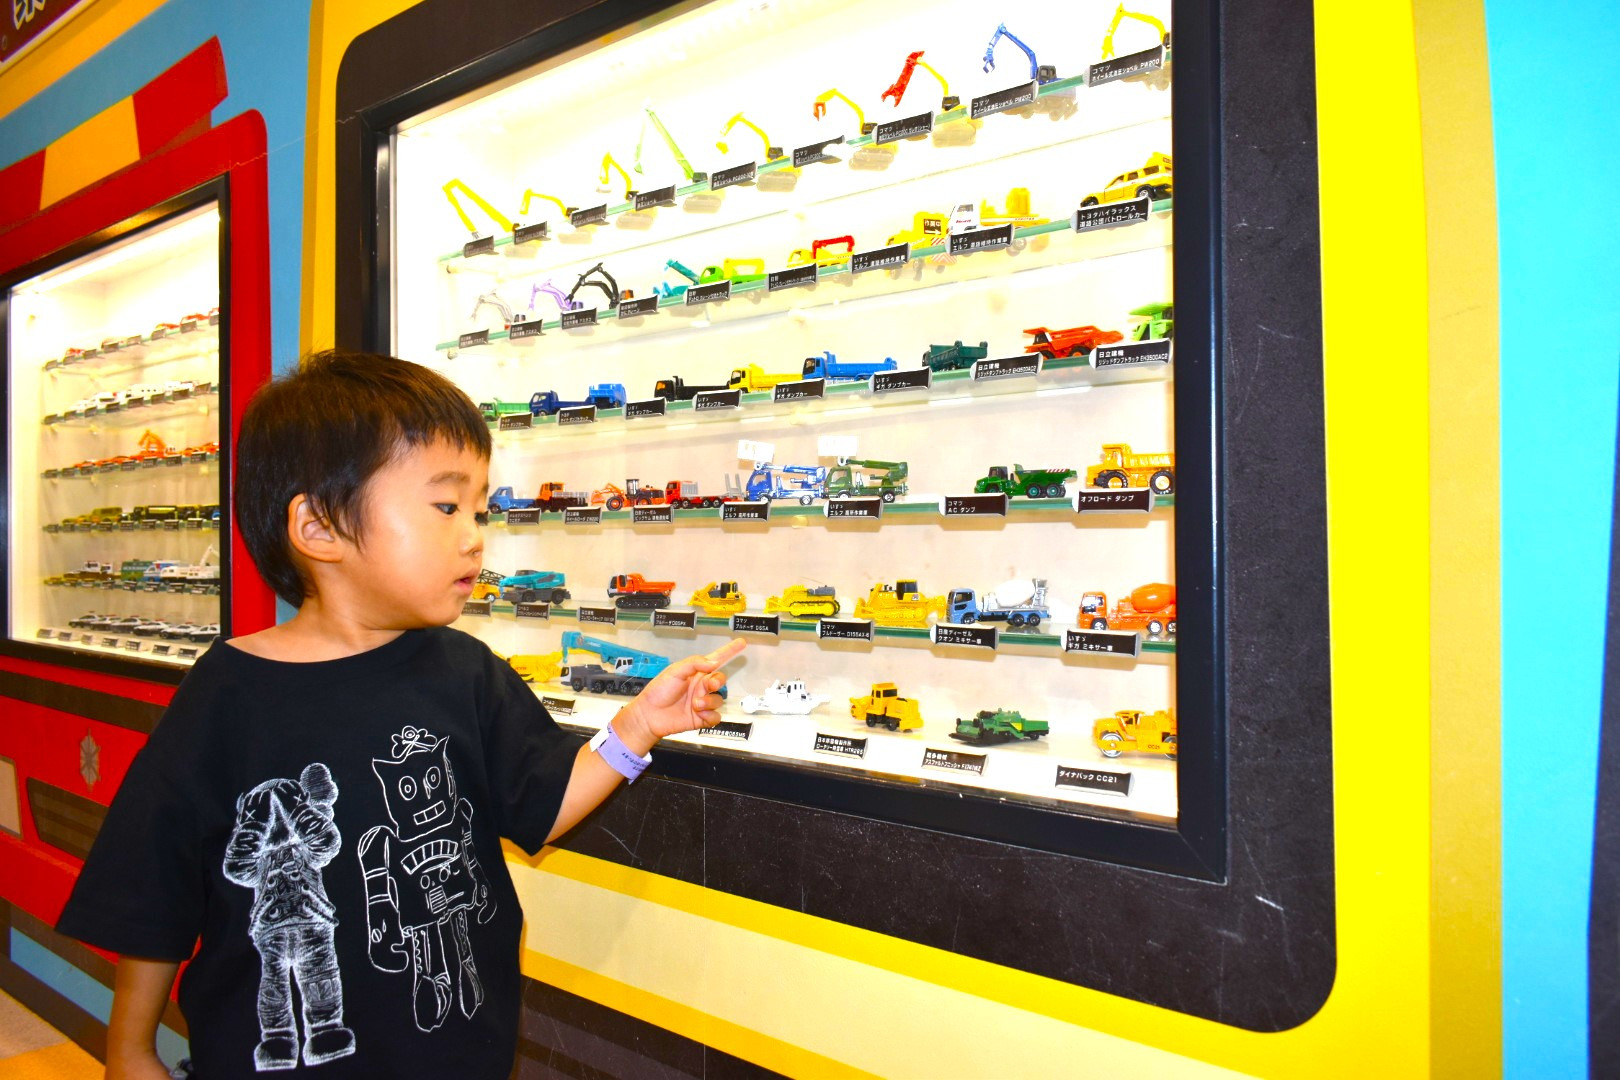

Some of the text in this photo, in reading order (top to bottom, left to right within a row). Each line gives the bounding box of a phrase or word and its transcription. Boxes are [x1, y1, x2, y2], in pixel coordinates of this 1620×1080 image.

[1092, 64, 1111, 75] コマツ
[974, 99, 990, 108] コマツ
[1081, 205, 1136, 219] トヨタハイラックス
[1099, 350, 1124, 359] 日立建機
[978, 362, 1000, 371] 日立建機
[887, 380, 912, 389] ダンプカー
[1081, 495, 1135, 503] オフロード ダンプ
[938, 628, 973, 637] 日産ディーゼル
[938, 635, 982, 645] クオン ミキサー車
[1068, 634, 1087, 642] いすゞ
[1067, 642, 1113, 652] ギガ ミキサー車
[1096, 774, 1117, 784] CC21
